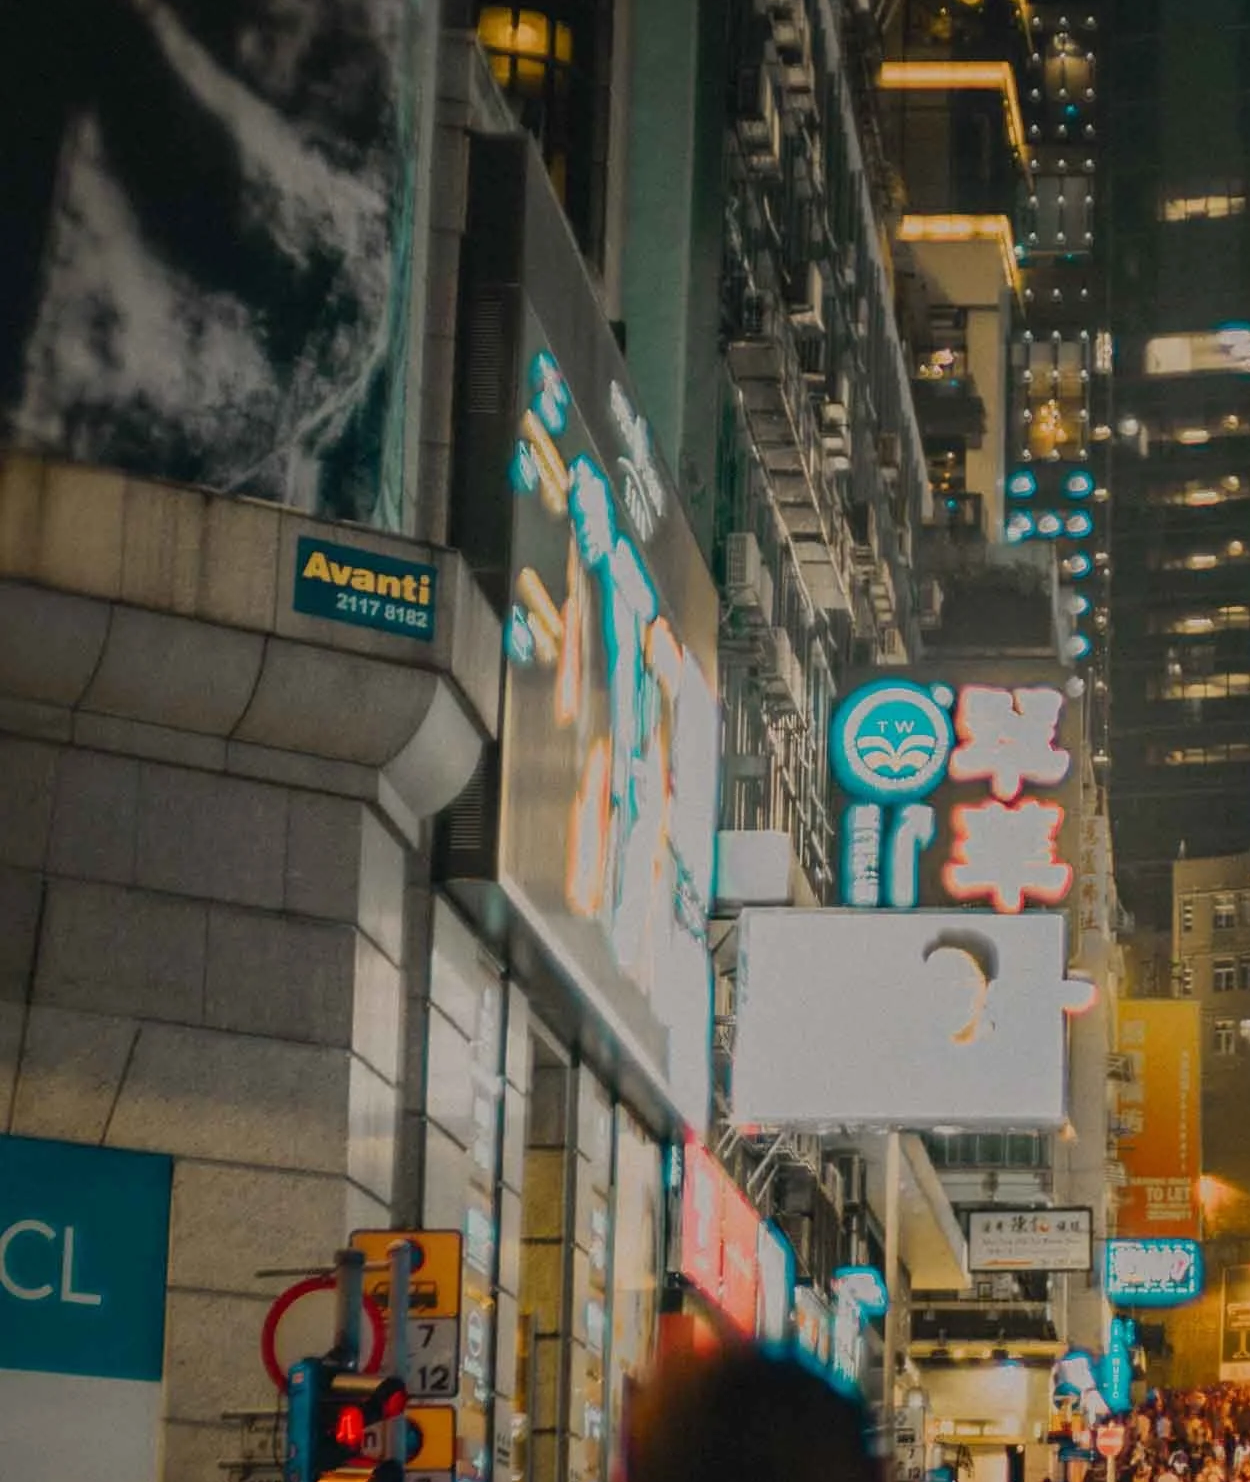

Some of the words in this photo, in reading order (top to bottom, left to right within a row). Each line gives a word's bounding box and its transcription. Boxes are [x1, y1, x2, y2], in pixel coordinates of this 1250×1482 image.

[303, 551, 431, 606] Avanti
[336, 592, 381, 617] 2117
[384, 603, 429, 629] 8182
[1146, 1186, 1164, 1202] TO
[1167, 1186, 1191, 1202] LET
[417, 1325, 435, 1349] 7
[417, 1367, 450, 1392] 12
